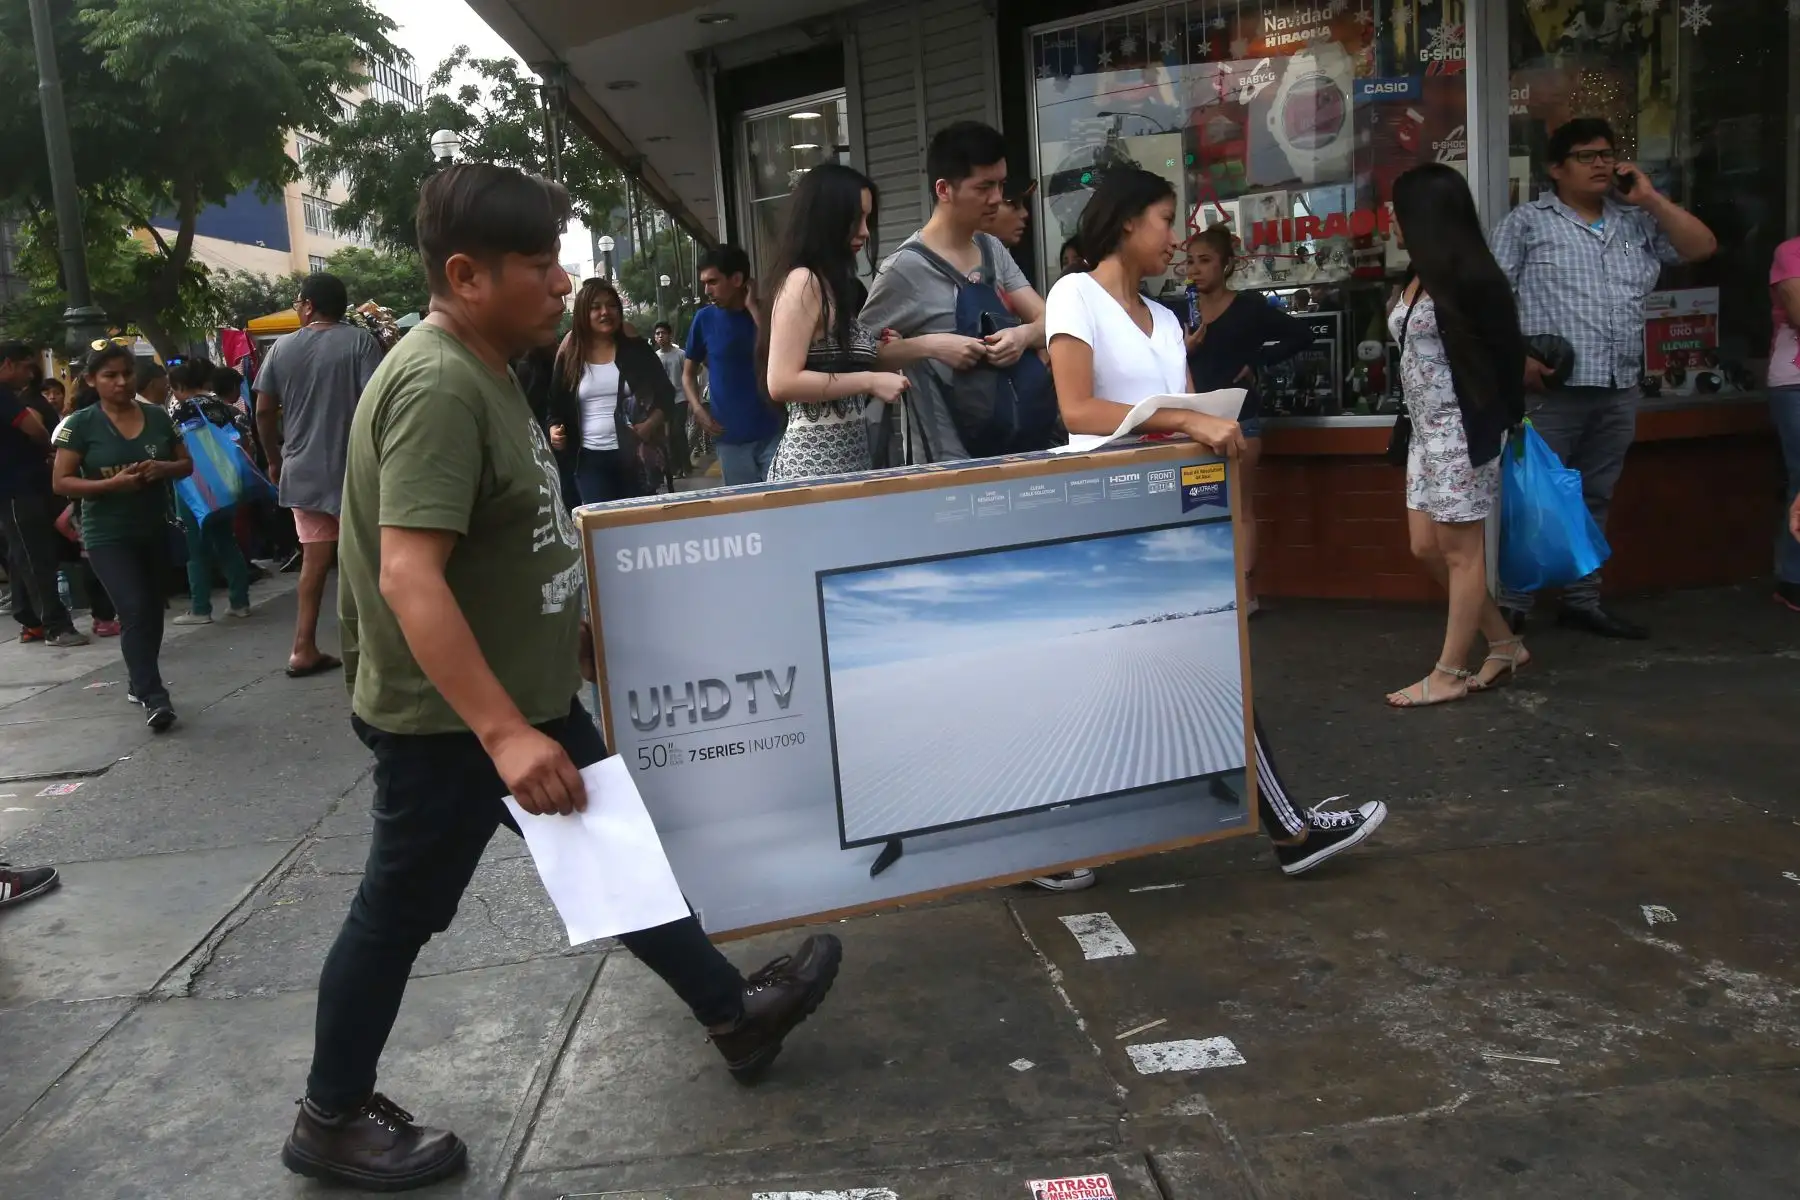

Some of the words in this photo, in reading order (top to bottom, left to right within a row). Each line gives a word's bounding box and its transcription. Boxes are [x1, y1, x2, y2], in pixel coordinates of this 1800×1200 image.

[1264, 7, 1333, 32] Navidad
[1363, 82, 1409, 94] CASIO
[1309, 325, 1329, 334] CE
[1110, 473, 1140, 483] HDMI
[1149, 471, 1173, 481] FRONT
[616, 532, 763, 573] SAMSUNG
[627, 678, 732, 732] UHD
[735, 666, 797, 714] TV
[688, 749, 697, 762] 7
[699, 741, 745, 761] SERIES
[754, 731, 806, 751] NU7090
[1047, 1177, 1108, 1192] ATRASO
[1049, 1188, 1113, 1200] MENSTRUAL
